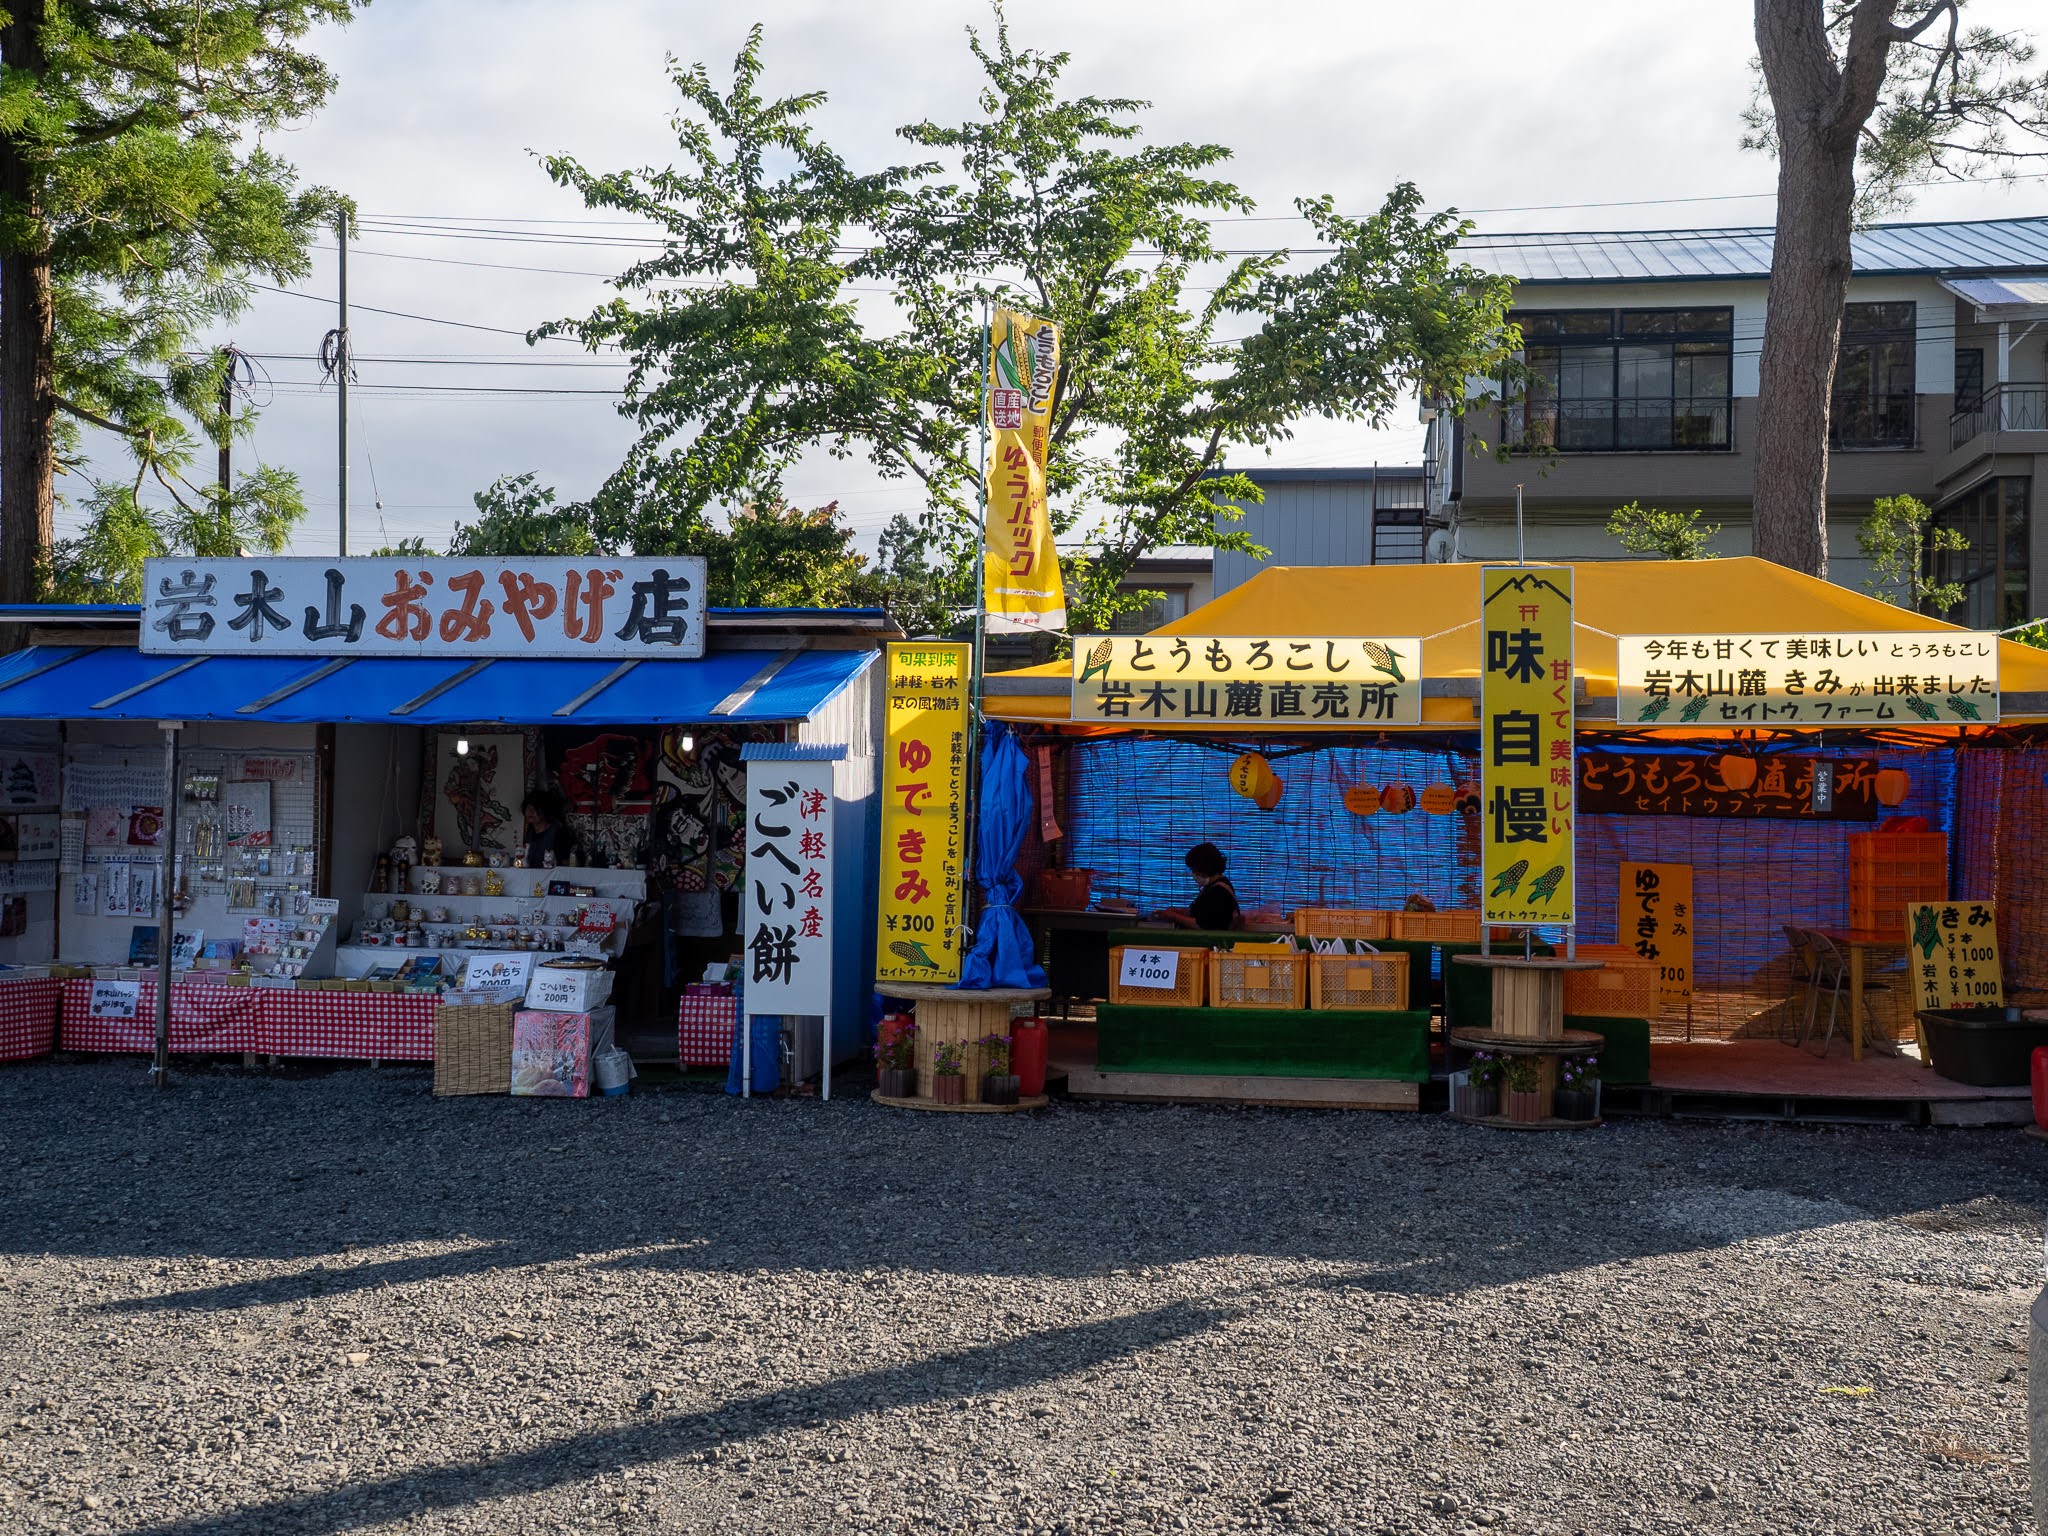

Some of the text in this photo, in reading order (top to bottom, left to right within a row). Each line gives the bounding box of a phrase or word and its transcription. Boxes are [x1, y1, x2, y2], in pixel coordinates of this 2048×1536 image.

[1028, 326, 1055, 414] とうもろこし
[1003, 446, 1038, 577] ゆうパック
[153, 569, 692, 645] 岩木山おみやげ店
[899, 652, 957, 667] 旬果到来
[1130, 637, 1351, 674] とうもろこし
[1644, 638, 1879, 660] 今年も甘くて美味しい
[1097, 680, 1400, 720] 岩木山麓直売所
[1643, 669, 1767, 697] 岩木山麓
[892, 695, 960, 711] 夏の風物詩
[1488, 628, 1548, 843] 味自慢
[1550, 659, 1572, 836] 甘くて美味しい
[1817, 770, 1828, 805] 営業中
[894, 739, 932, 905] ゆできみ
[798, 787, 828, 938] 津軽名産
[748, 781, 801, 985] ごへい餅
[1487, 910, 1571, 920] セイトウファーム
[1635, 869, 1660, 960] ゆできみ
[1942, 905, 1993, 928] きみ
[1948, 933, 1973, 944] 5本
[1140, 954, 1161, 965] 4本
[1949, 966, 1976, 979] 6本
[540, 983, 576, 993] ごへいもち
[544, 993, 568, 1003] 200円
[1922, 964, 1940, 1008] 岩木山
